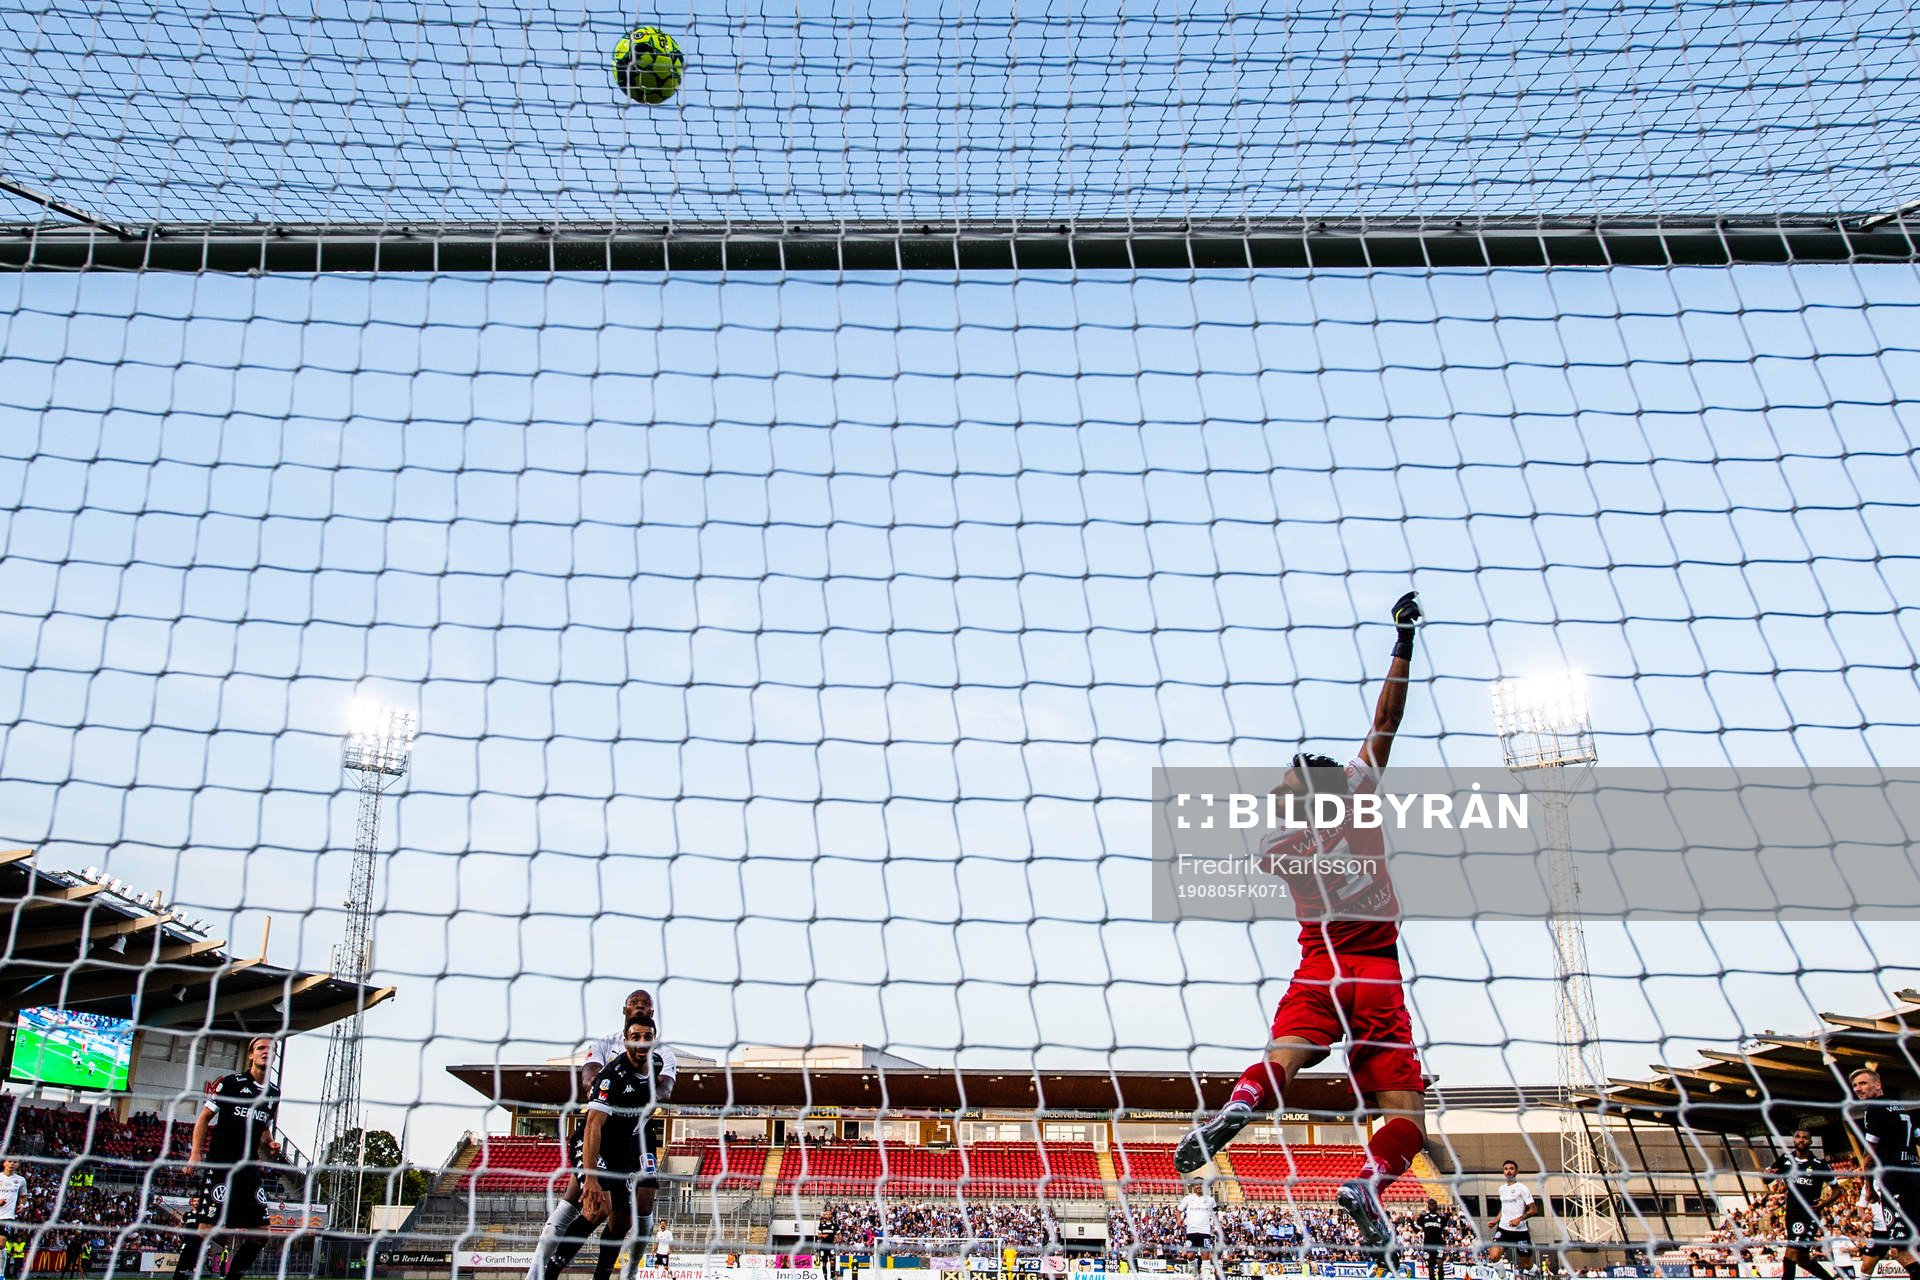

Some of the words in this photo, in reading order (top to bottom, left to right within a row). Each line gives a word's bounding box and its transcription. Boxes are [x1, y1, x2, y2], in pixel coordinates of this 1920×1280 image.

[1266, 1111, 1309, 1120] MACHLOGE
[401, 1255, 419, 1263] Rent
[485, 1255, 505, 1265] Grant
[506, 1255, 533, 1264] Thornto
[776, 1270, 818, 1280] InnoBo
[972, 1271, 1038, 1280] XL-BYG
[1338, 1268, 1367, 1276] LIGAN
